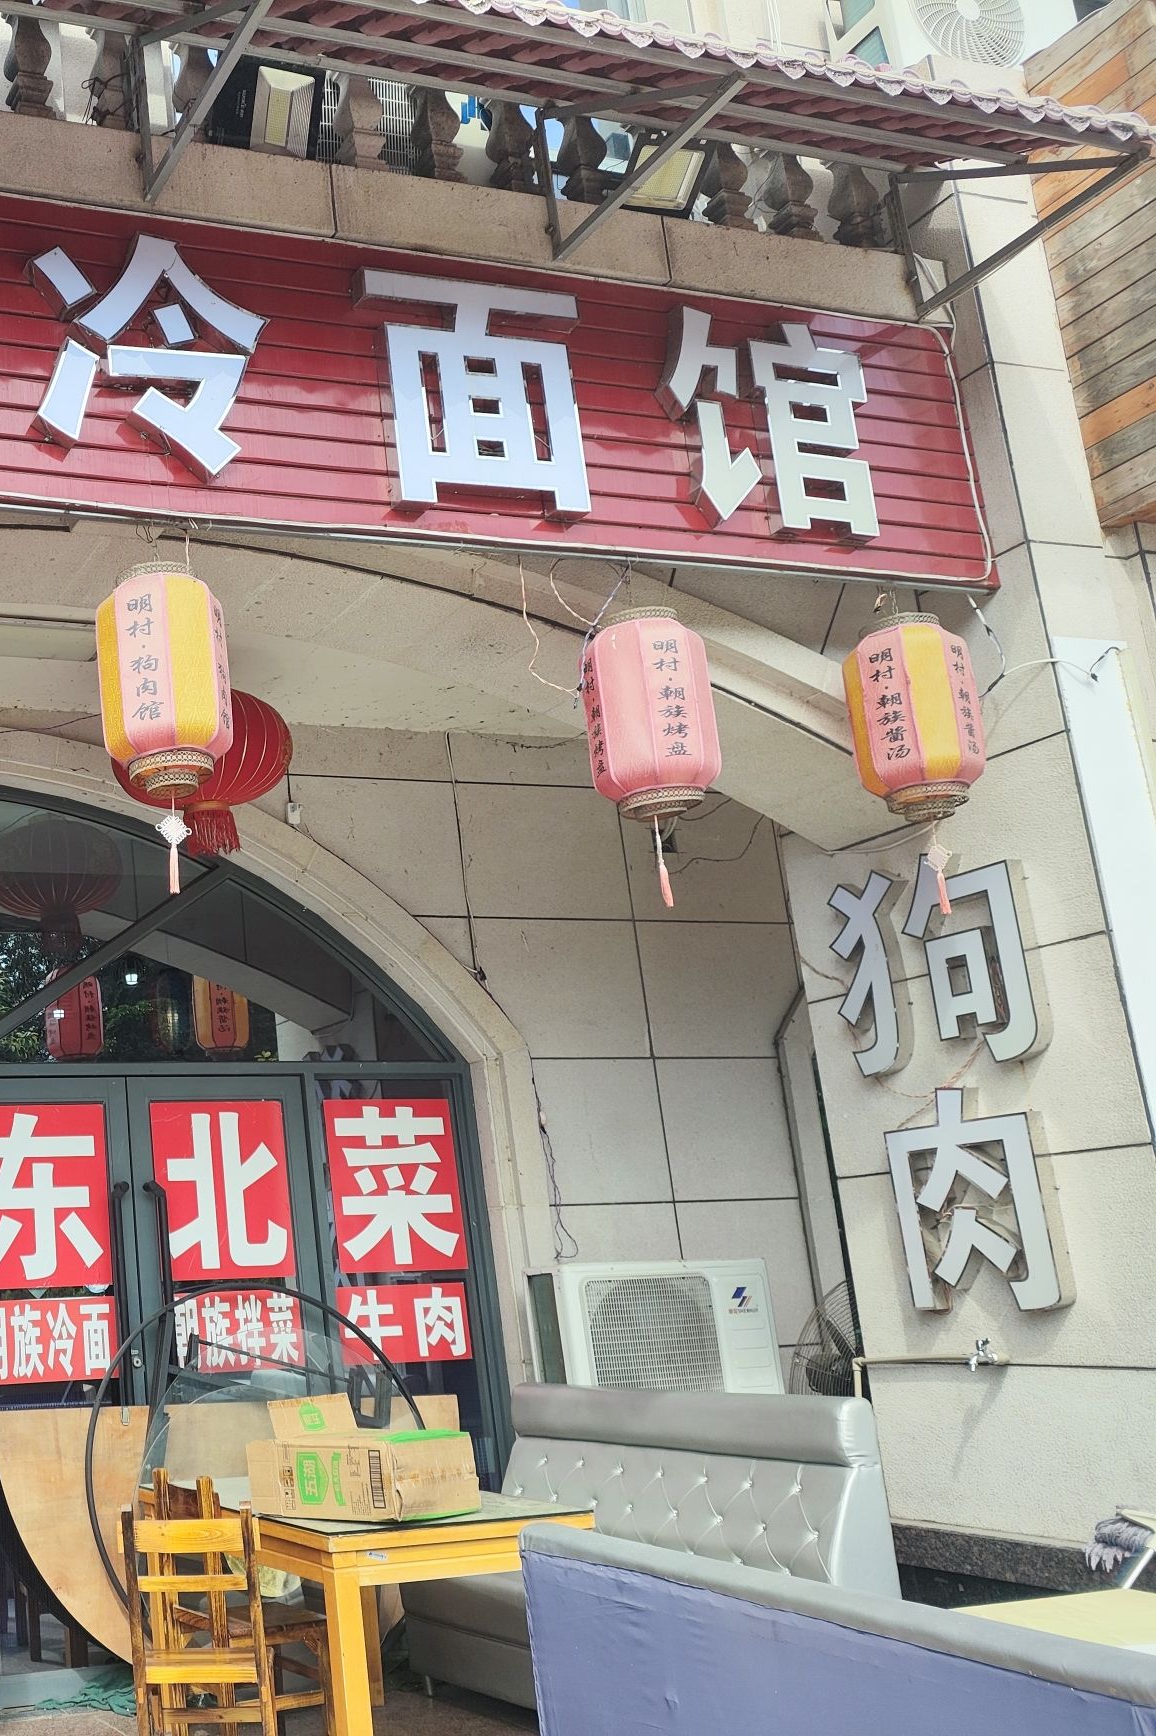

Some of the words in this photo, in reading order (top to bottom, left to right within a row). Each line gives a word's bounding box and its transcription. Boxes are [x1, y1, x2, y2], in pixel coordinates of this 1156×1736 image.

[827, 853, 1061, 1312] 狗肉
[174, 1292, 299, 1369] 朝族拌菜
[344, 1286, 467, 1361] 牛肉
[303, 1459, 318, 1497] 五湖
